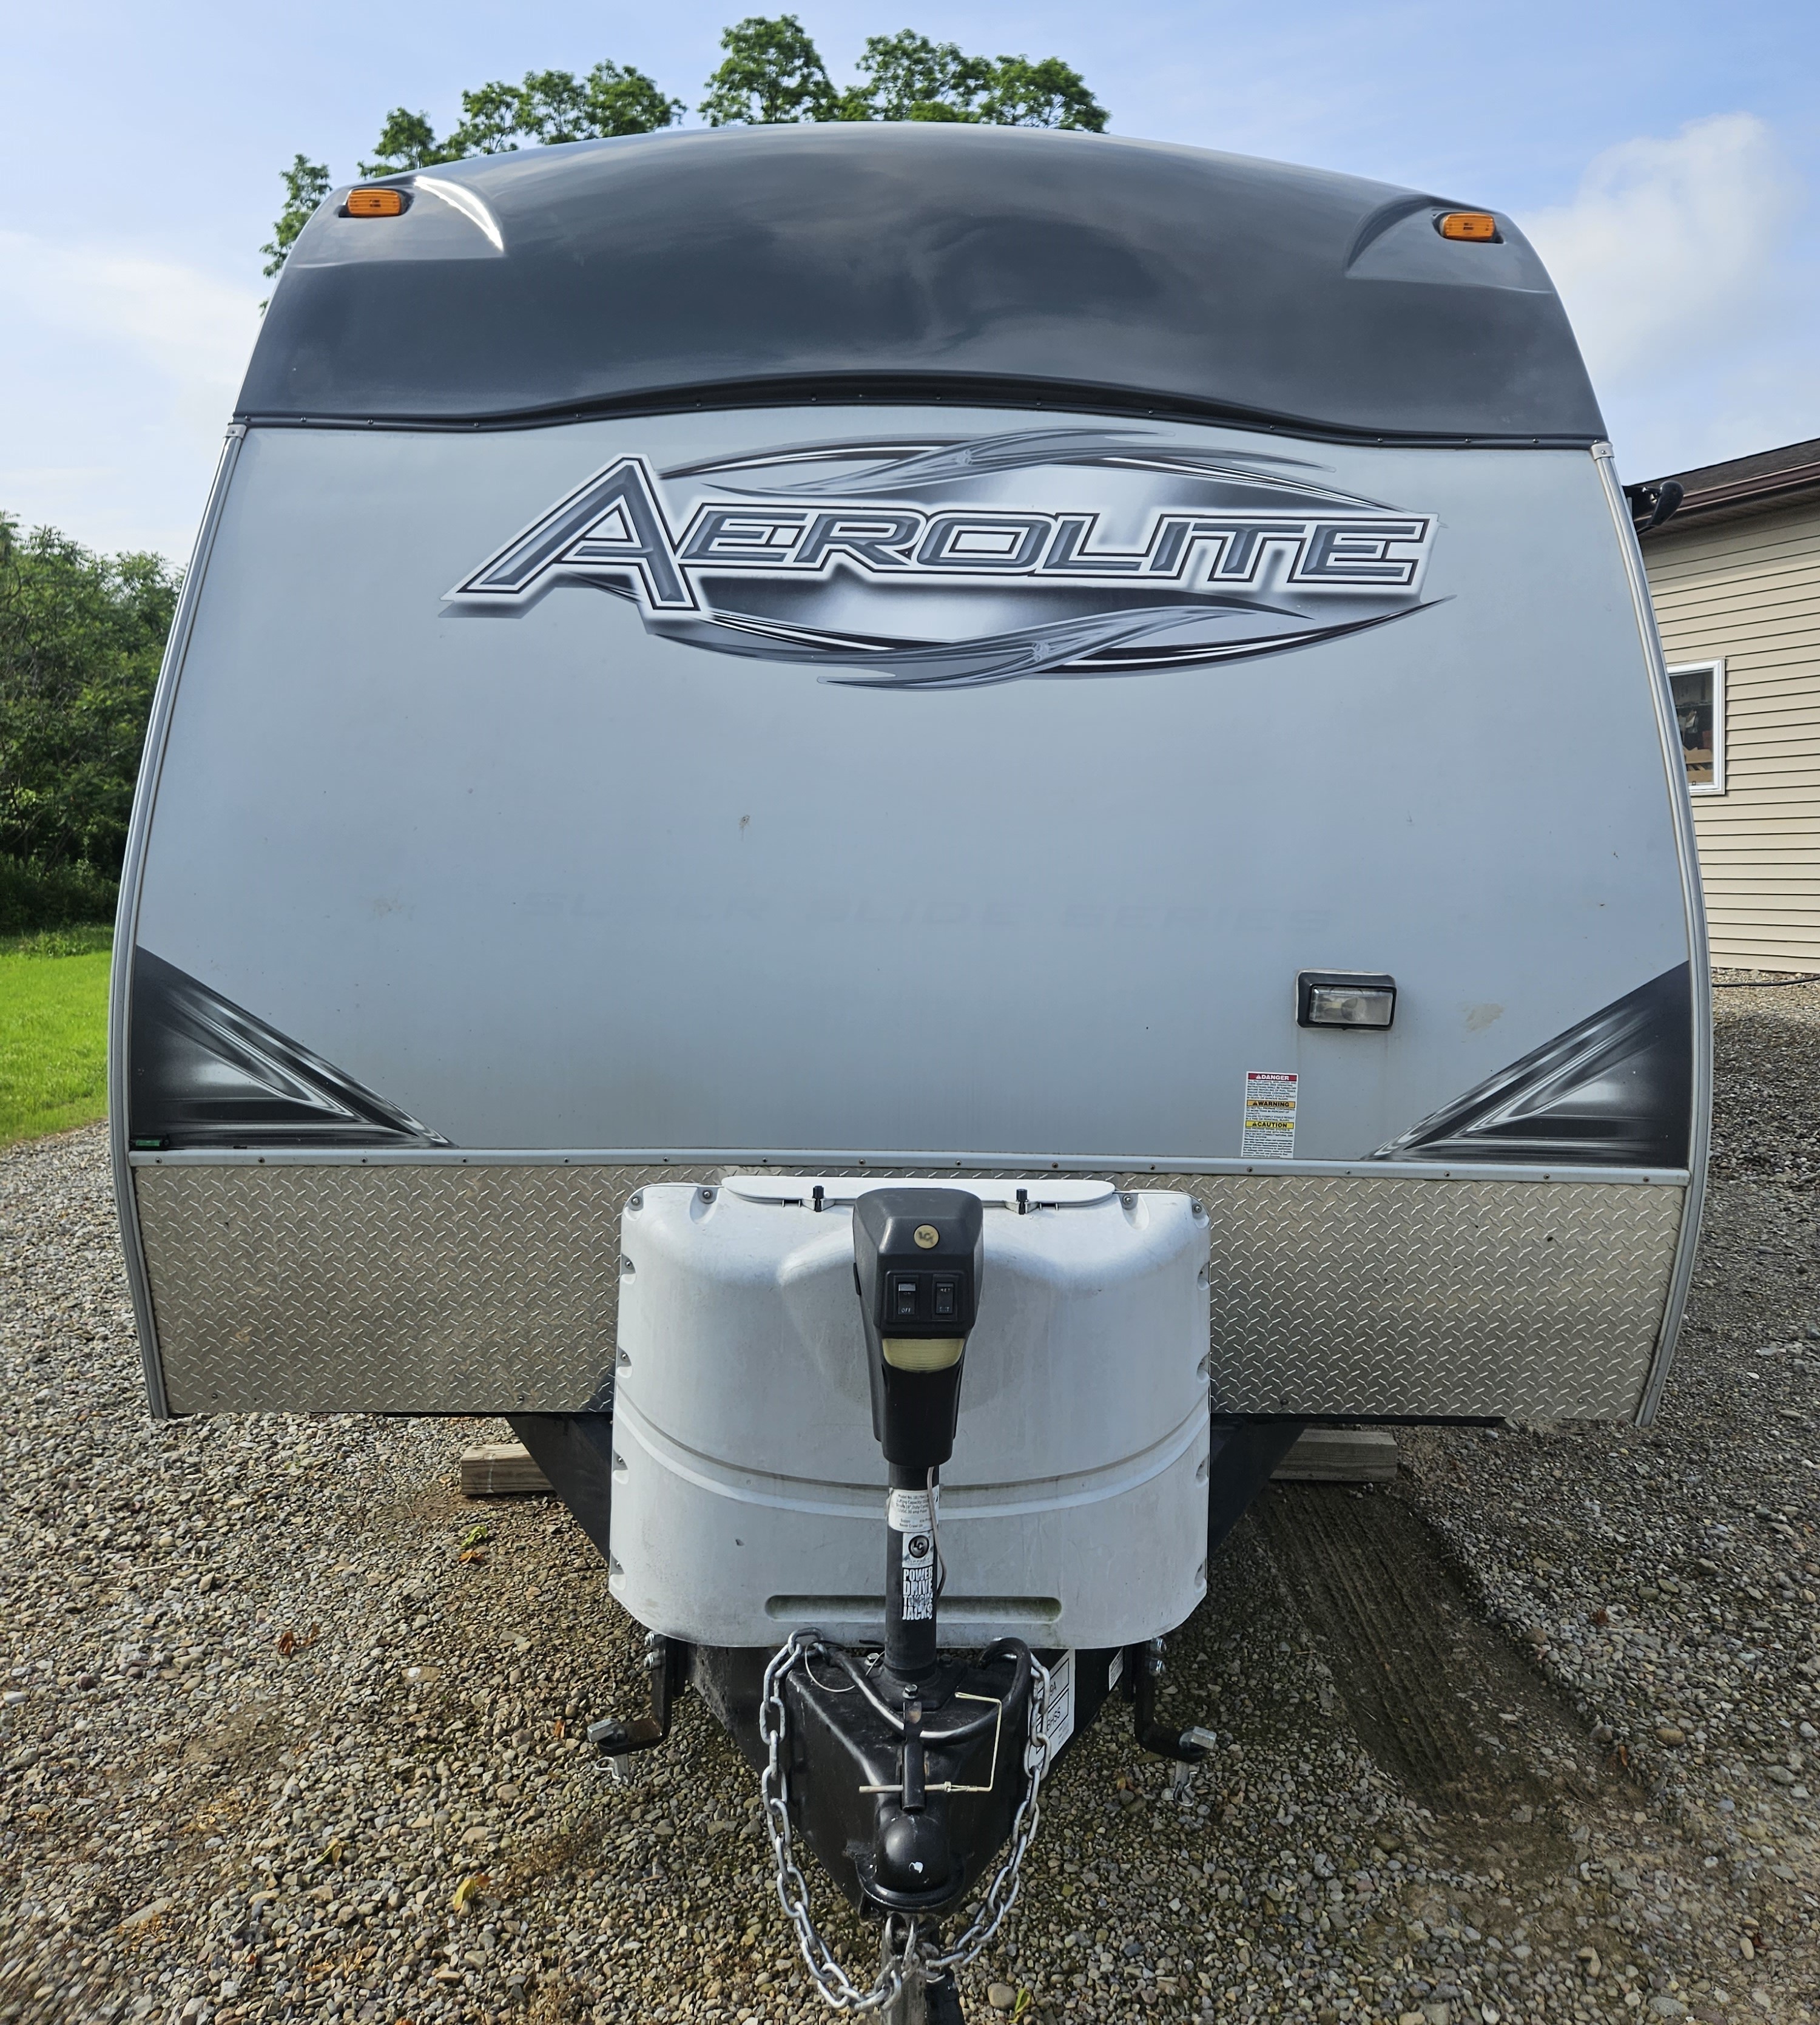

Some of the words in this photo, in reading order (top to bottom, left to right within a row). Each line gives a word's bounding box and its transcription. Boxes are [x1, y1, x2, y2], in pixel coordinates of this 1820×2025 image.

[451, 454, 1434, 611] AEROLITE
[903, 1566, 933, 1581] POWER
[903, 1578, 932, 1596] DRIVE
[902, 1603, 933, 1620] JACKS
